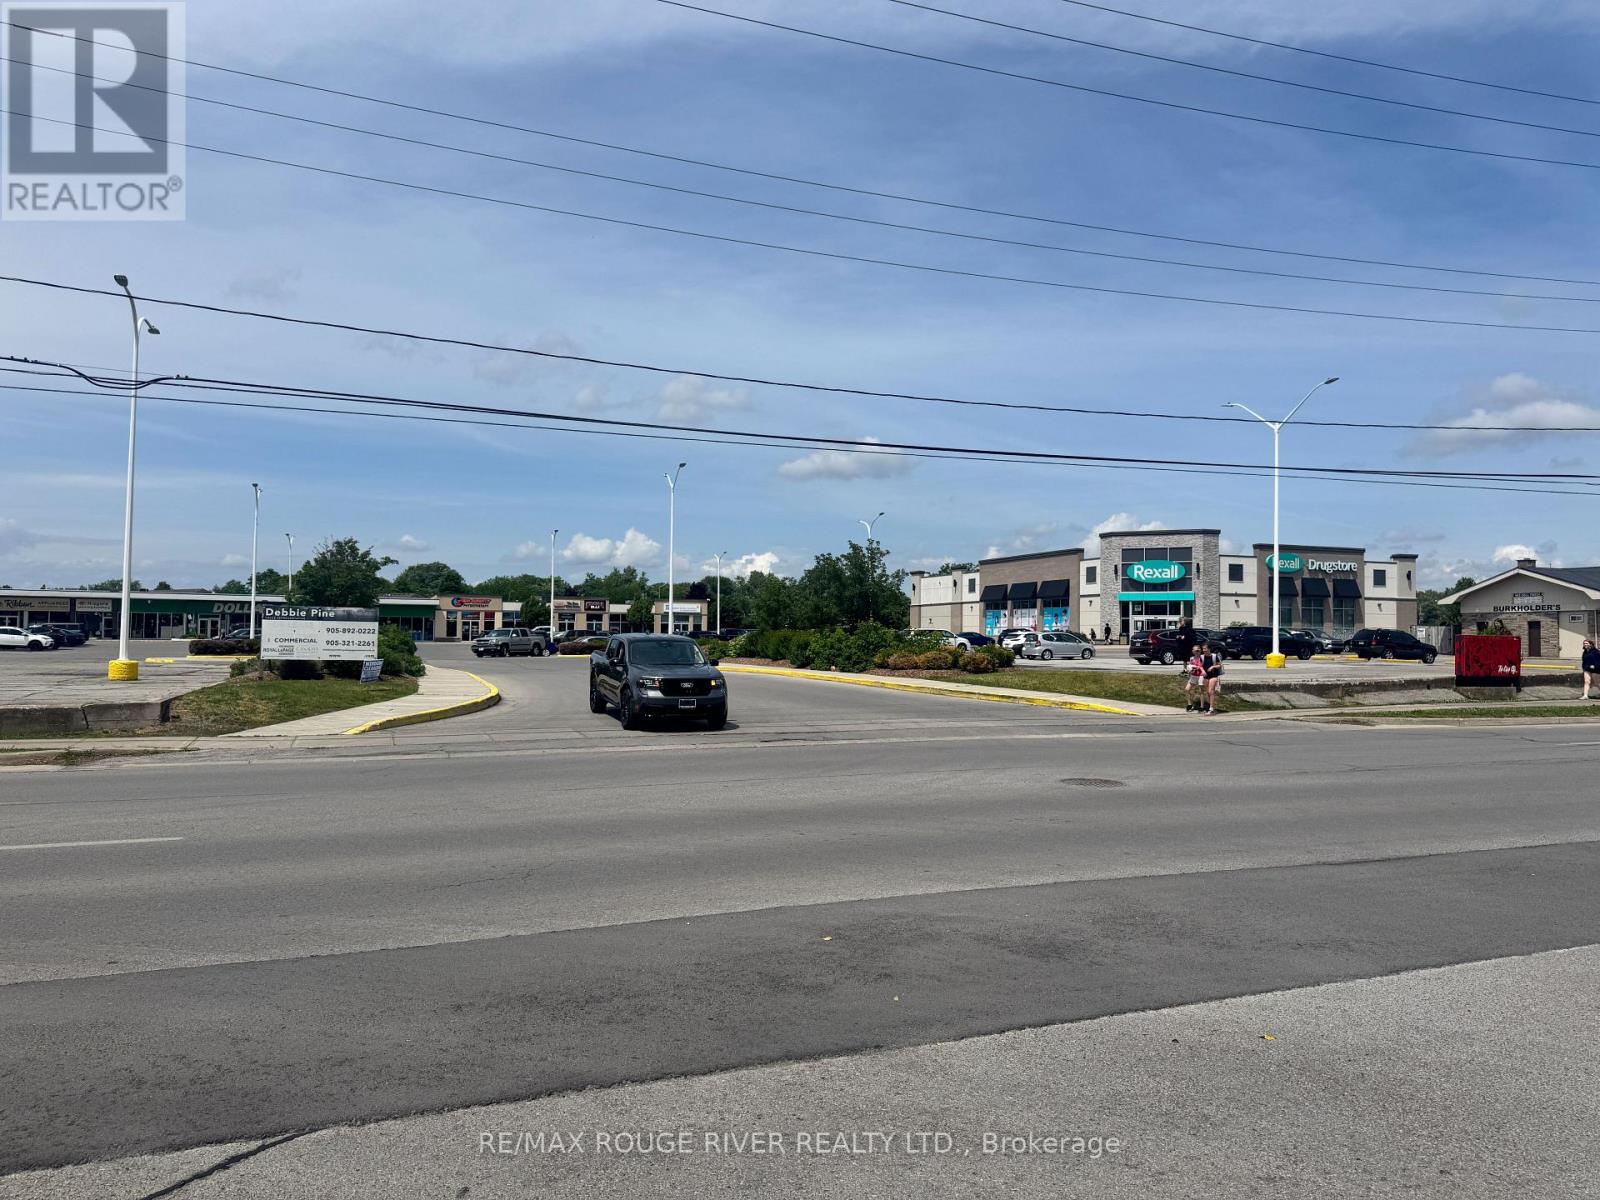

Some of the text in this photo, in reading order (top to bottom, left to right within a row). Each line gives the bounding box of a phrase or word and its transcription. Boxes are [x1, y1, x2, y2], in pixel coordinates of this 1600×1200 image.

[1272, 557, 1358, 573] exall Drugstore
[1133, 565, 1178, 580] Rexall
[212, 602, 264, 613] DOLLA
[265, 608, 335, 618] Debbie Pine
[1493, 604, 1561, 612] BURKHOLDER'S
